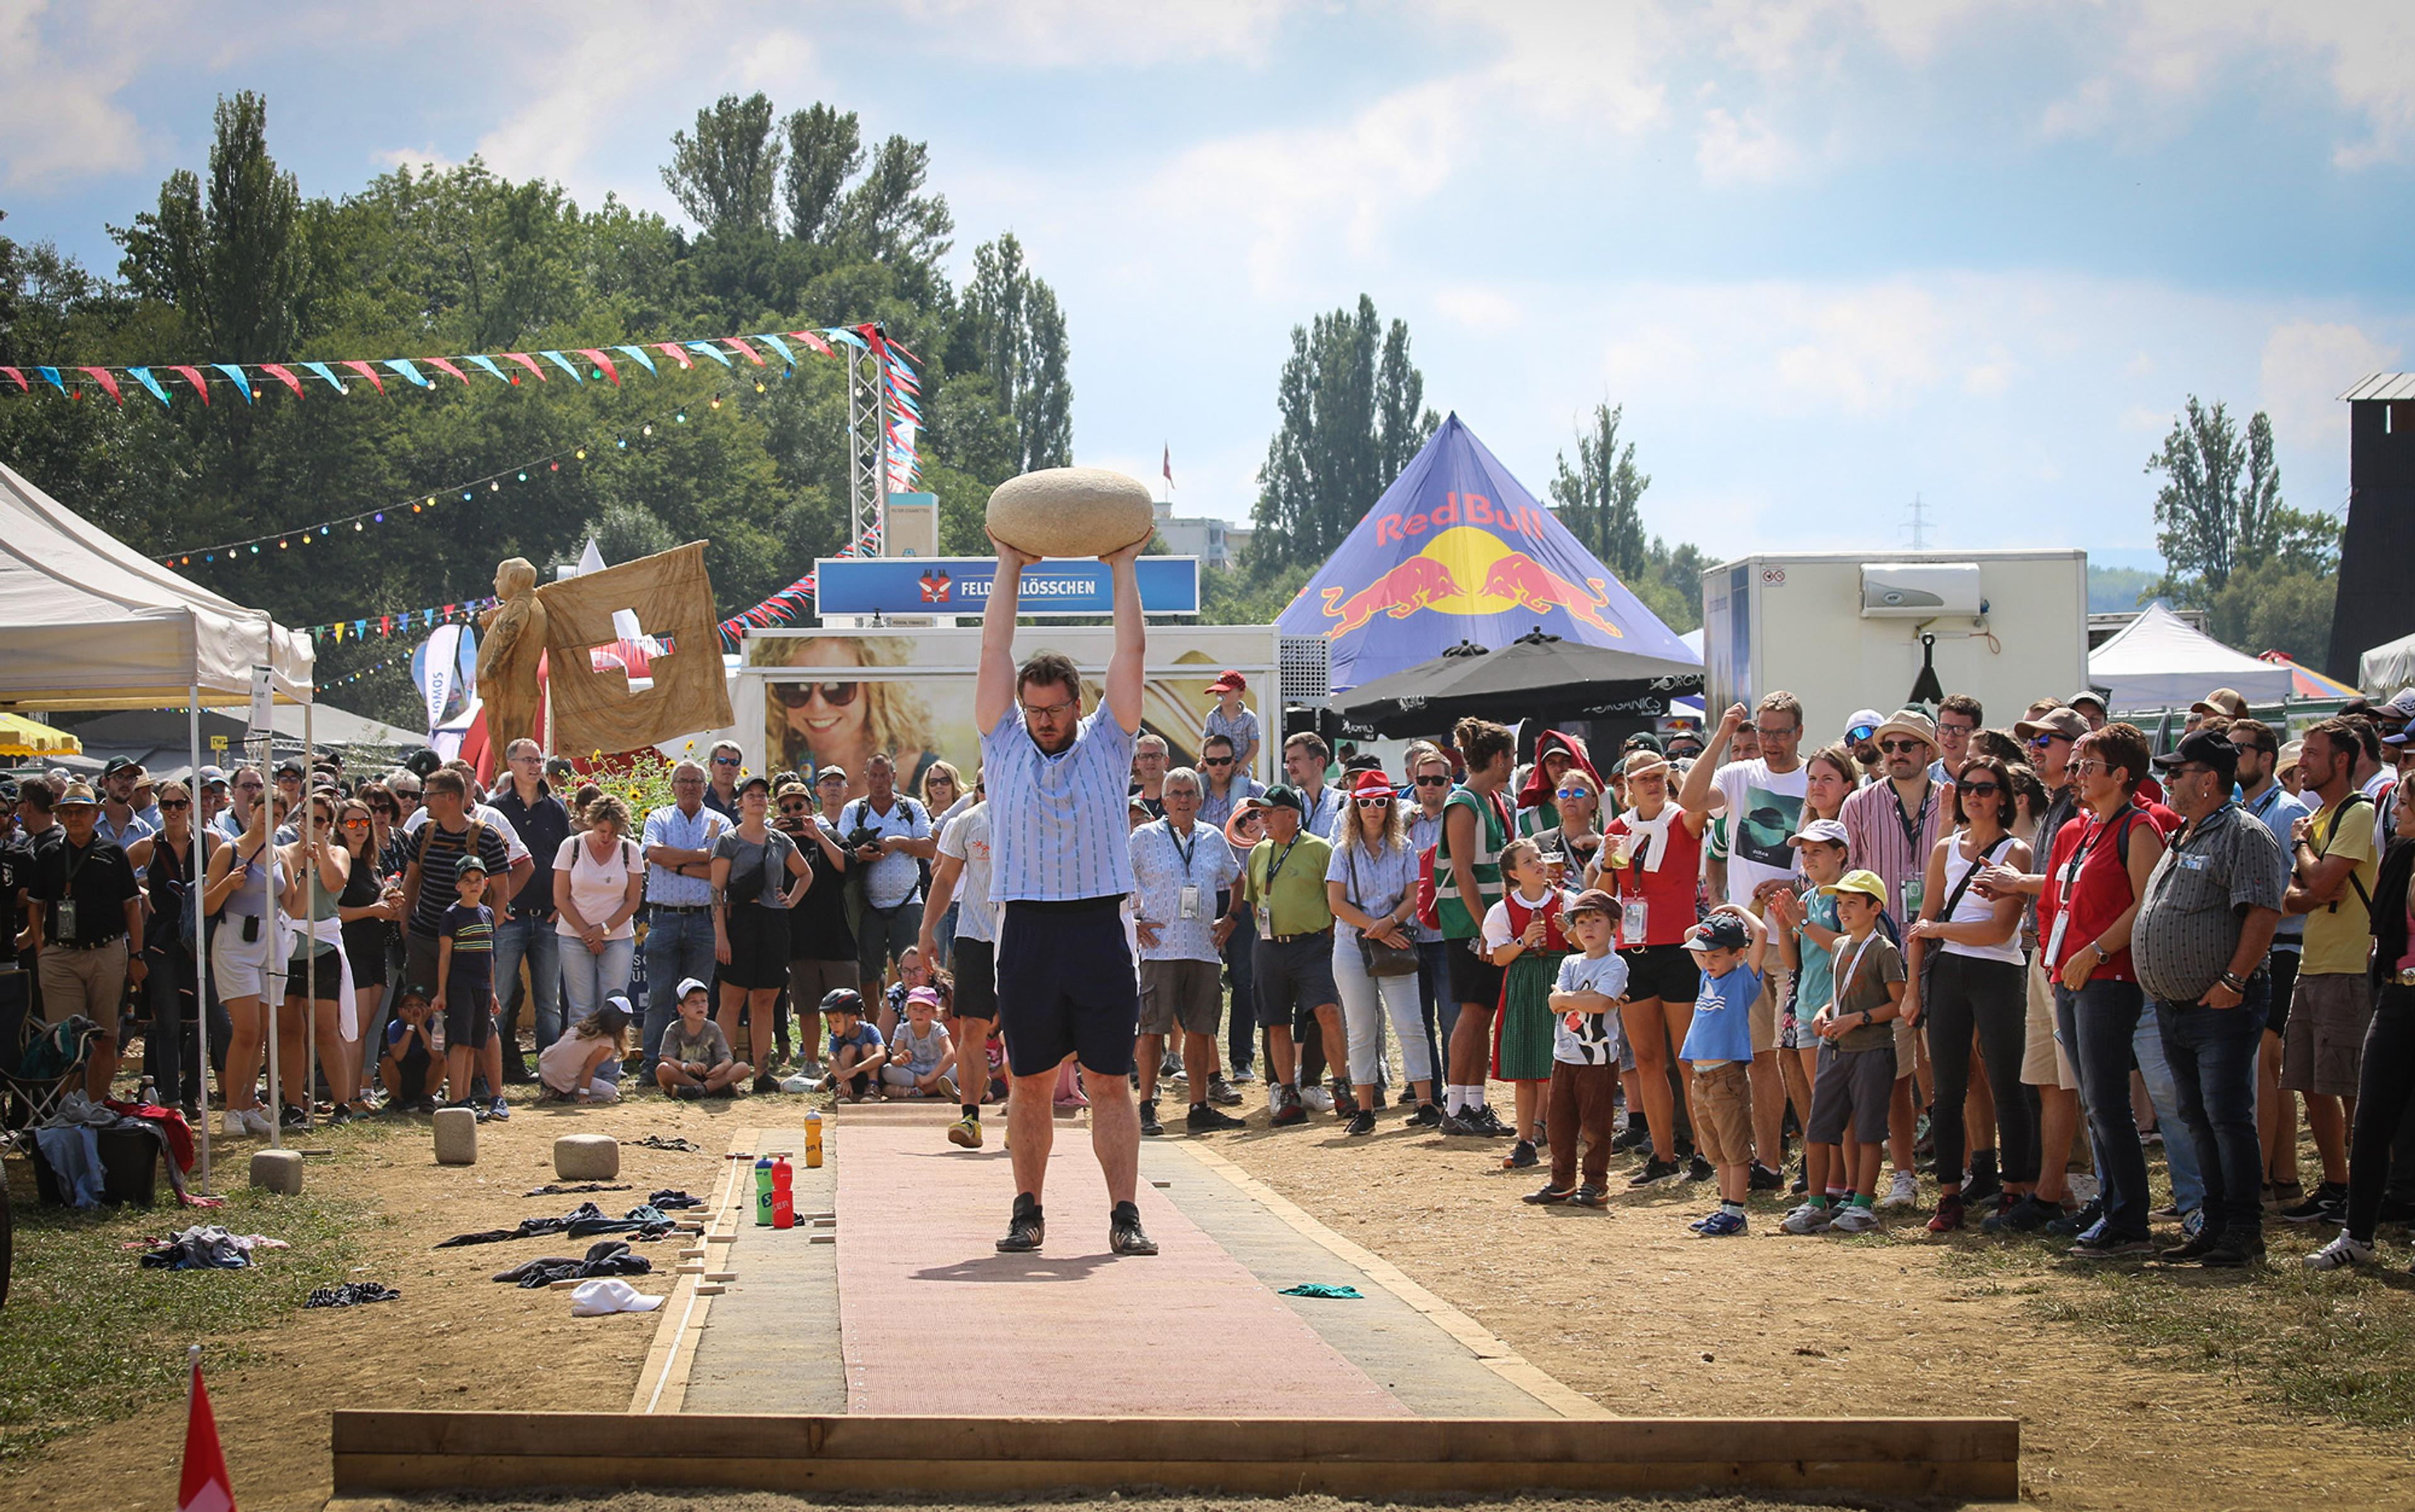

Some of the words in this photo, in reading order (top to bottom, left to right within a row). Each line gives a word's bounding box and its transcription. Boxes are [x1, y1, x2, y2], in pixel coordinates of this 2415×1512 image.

[1376, 492, 1458, 547] Red
[1464, 493, 1544, 540] Bull
[962, 578, 1096, 596] FELDLÖSSCHEN
[1663, 674, 1705, 690] ORGA
